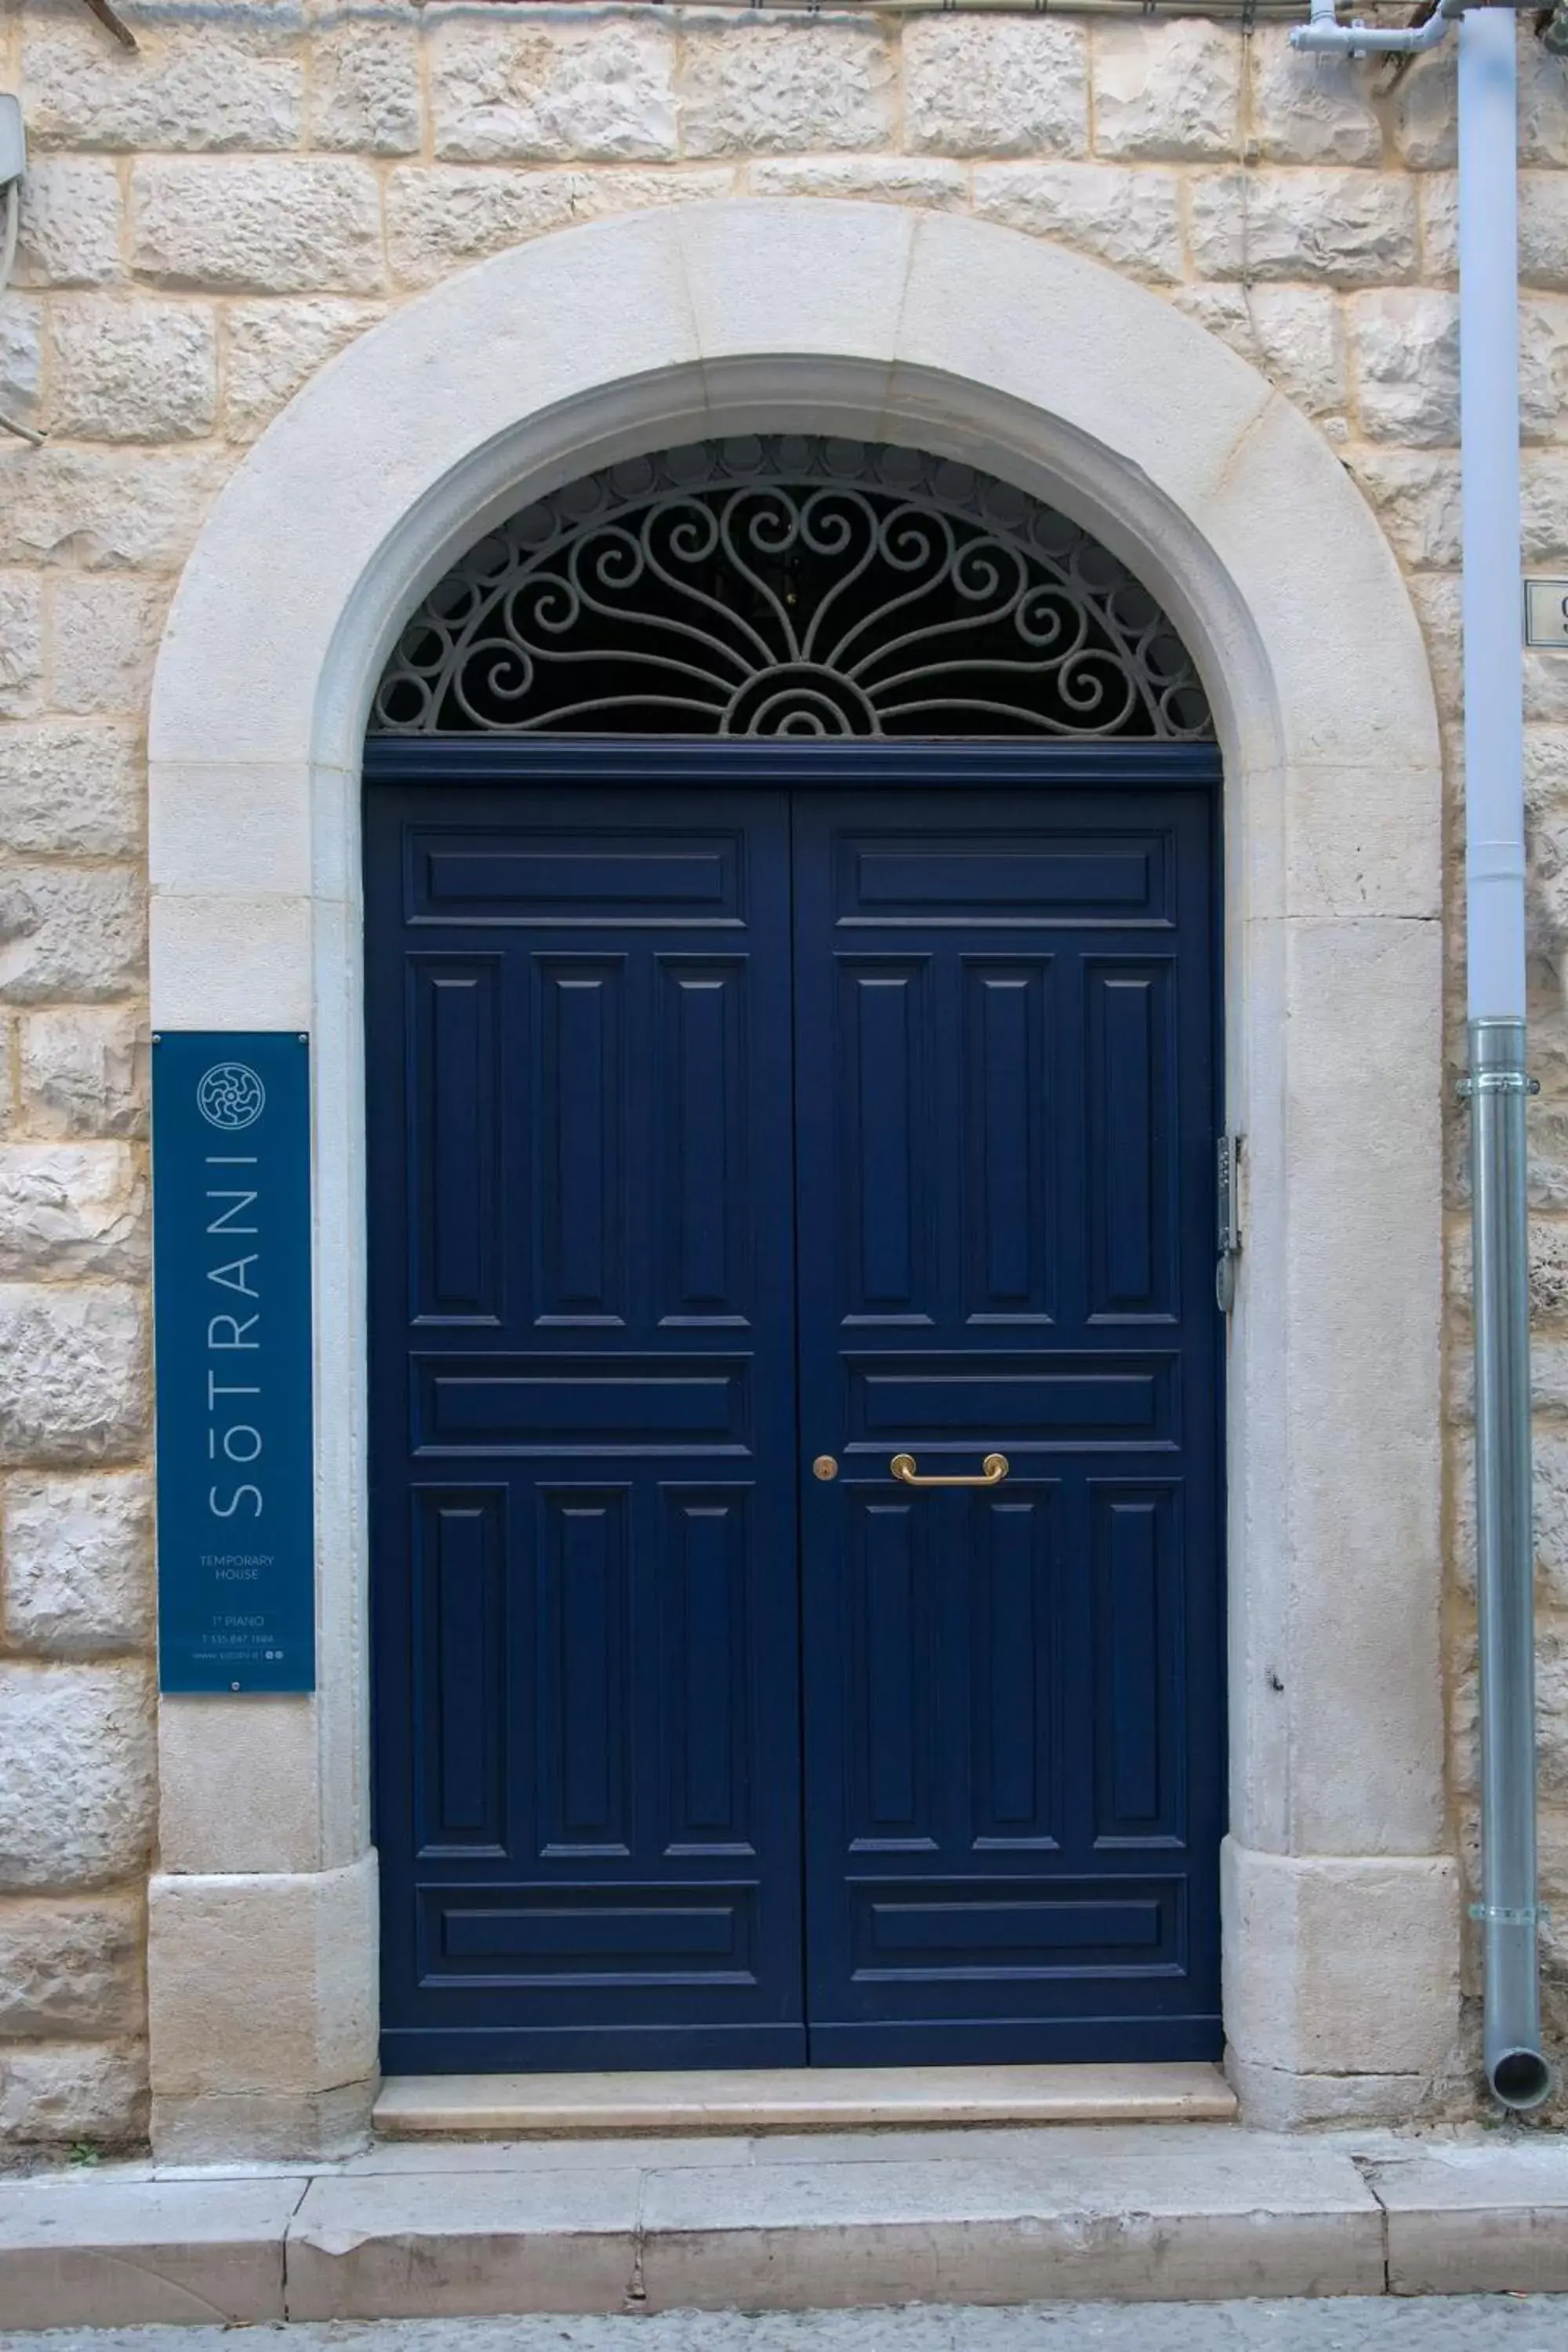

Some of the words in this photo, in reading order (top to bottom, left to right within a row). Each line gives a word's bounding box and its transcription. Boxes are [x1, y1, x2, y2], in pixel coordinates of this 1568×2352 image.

[201, 1555, 274, 1566] TEMPORARY
[216, 1570, 258, 1580] HOUSE
[225, 1616, 264, 1626] PIANO
